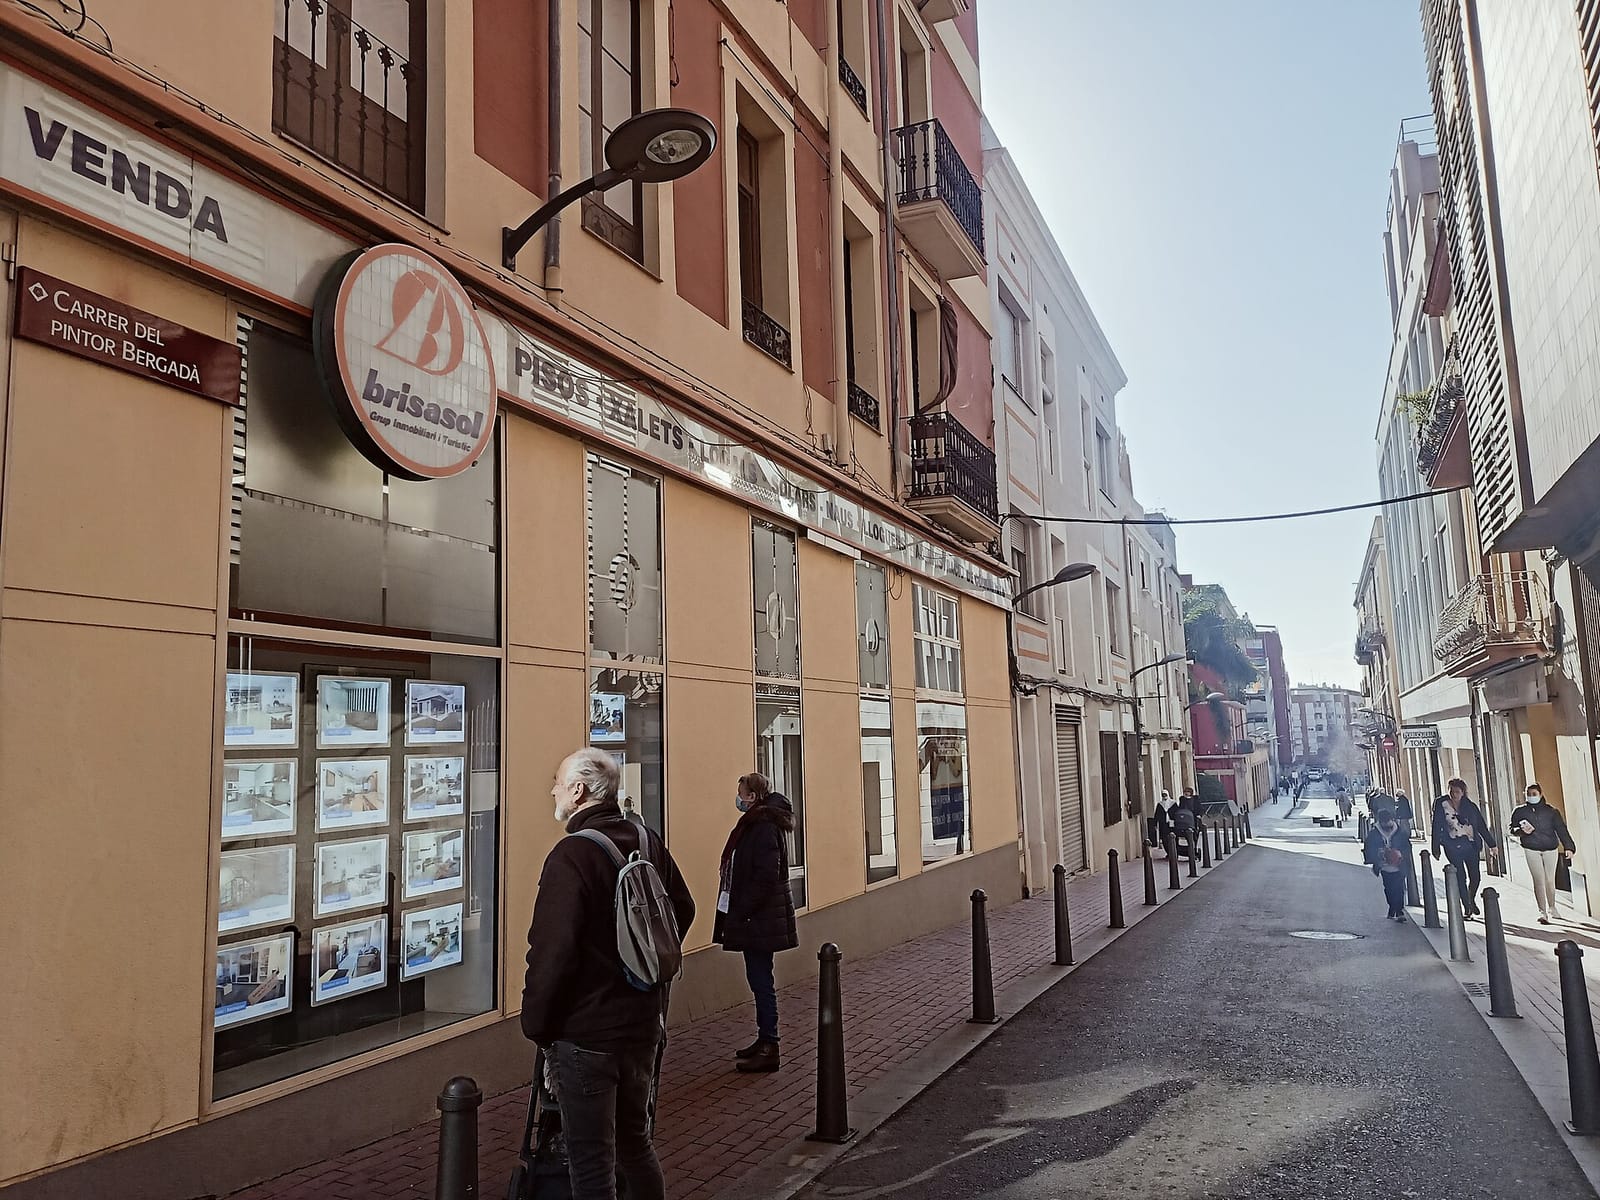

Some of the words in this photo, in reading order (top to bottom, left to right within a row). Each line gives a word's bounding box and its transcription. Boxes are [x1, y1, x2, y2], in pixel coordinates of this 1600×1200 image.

[24, 106, 228, 243] VENDA
[53, 290, 129, 334] CARRER
[134, 321, 165, 346] DEL
[51, 320, 116, 356] PINTOR
[122, 340, 201, 384] BERGADÀ
[514, 347, 590, 408] PISOS
[362, 368, 484, 439] brisasol
[370, 411, 391, 426] Grup
